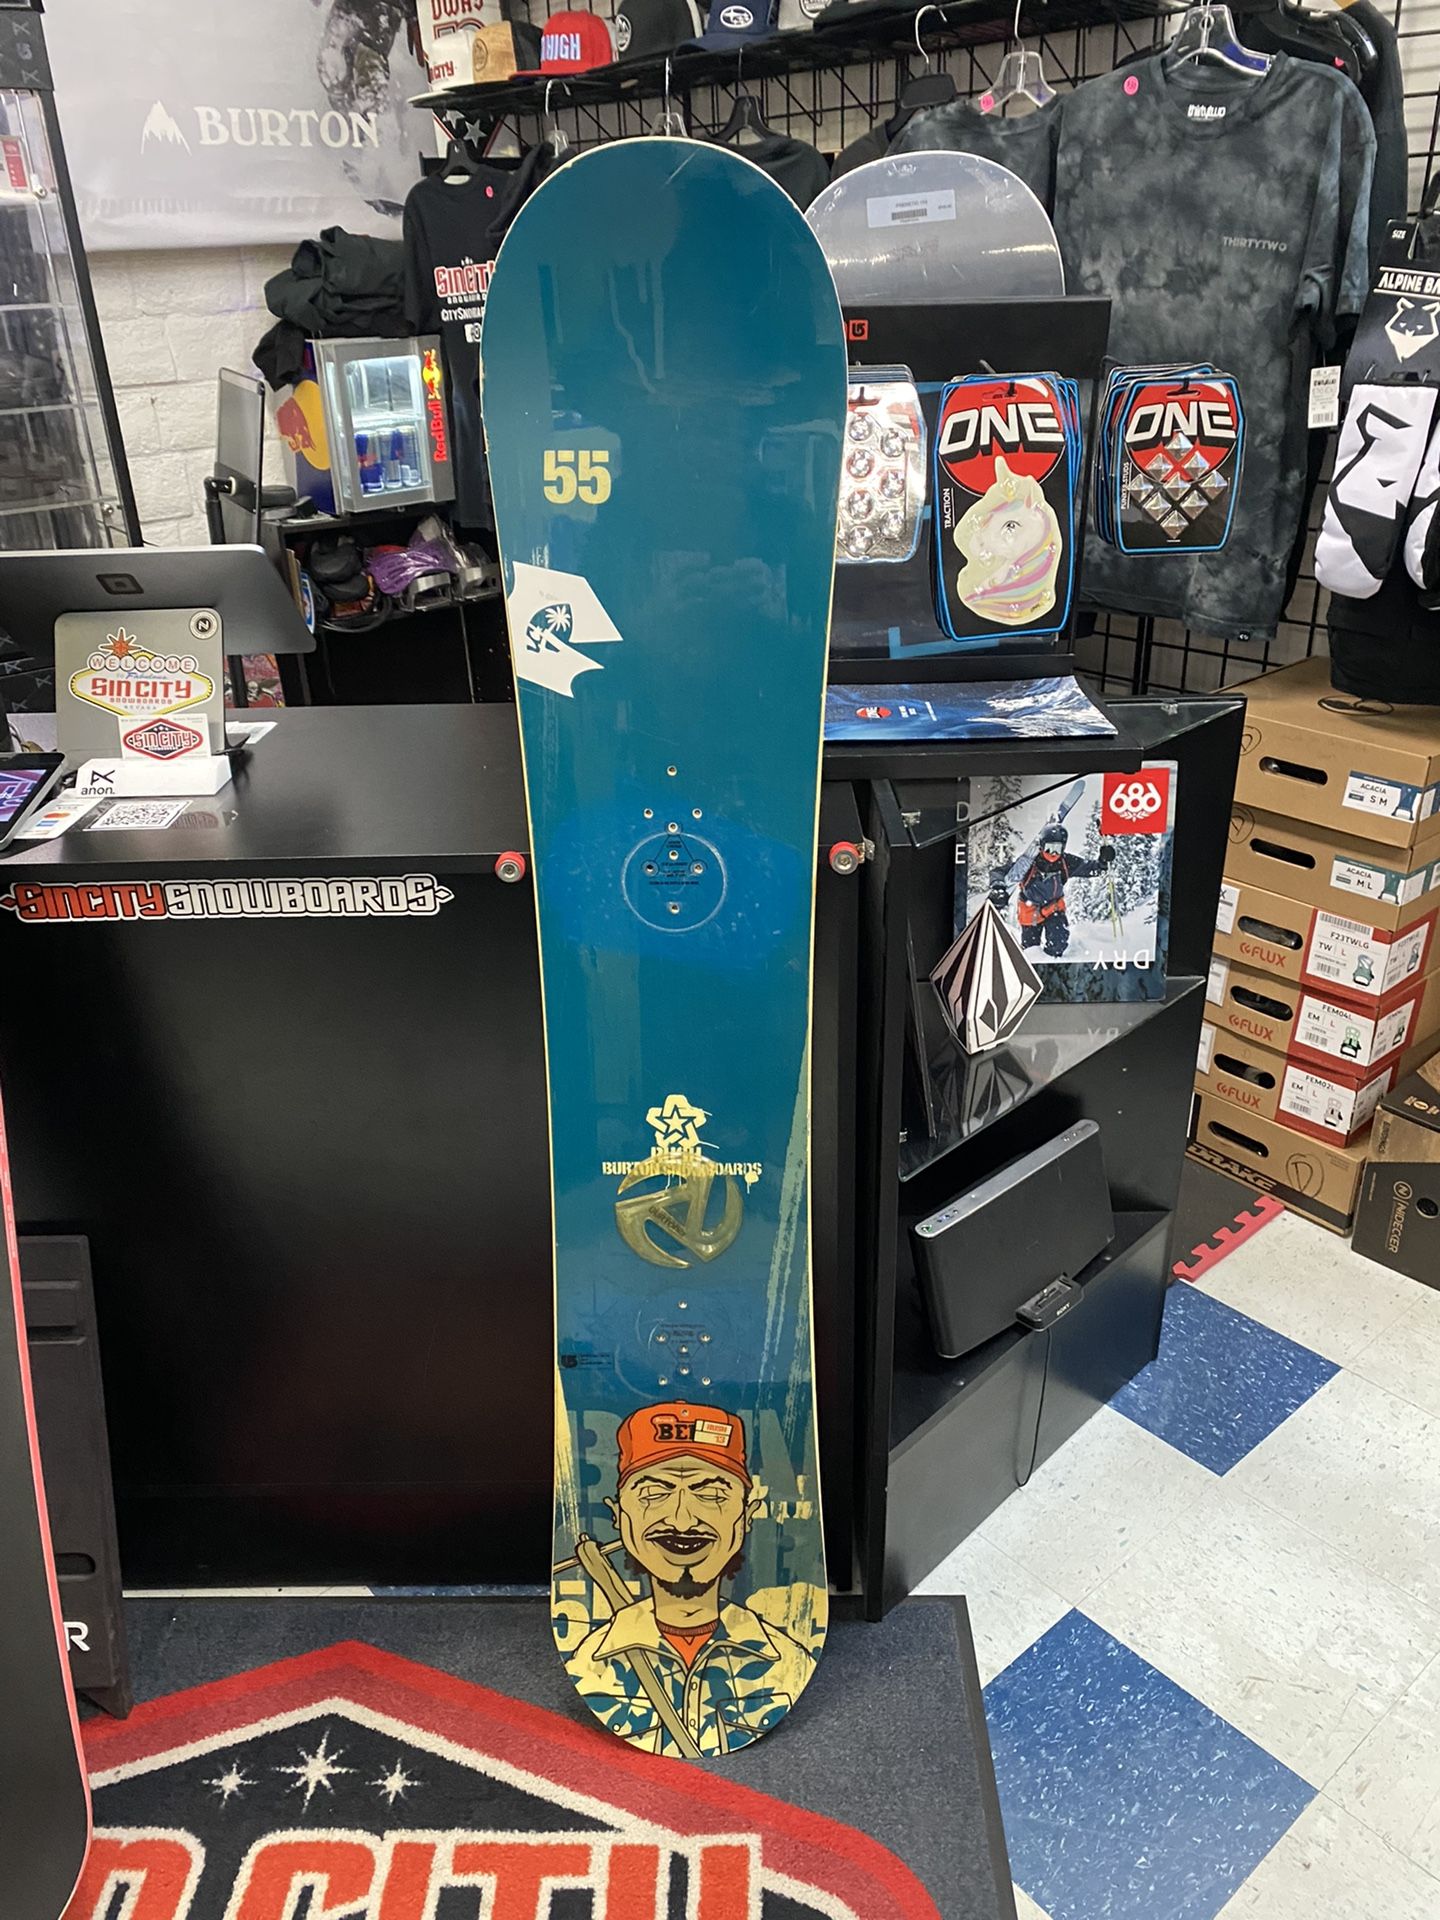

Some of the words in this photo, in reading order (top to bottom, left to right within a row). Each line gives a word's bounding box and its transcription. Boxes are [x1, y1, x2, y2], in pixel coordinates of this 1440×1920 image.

[193, 105, 380, 148] BURTON
[1223, 236, 1288, 252] THIRTYTWO
[1392, 230, 1407, 239] SIZE
[1378, 272, 1422, 293] ALPINE
[939, 402, 1066, 455] ONE
[1125, 401, 1238, 444] ONE
[543, 450, 611, 504] 55
[943, 488, 951, 528] TRACTION
[92, 657, 193, 671] WELCOME
[135, 679, 192, 699] CITY
[80, 786, 116, 796] anon.
[1109, 783, 1162, 814] 686
[1360, 782, 1387, 795] ACACIA
[1346, 867, 1372, 880] ACACIA
[1319, 942, 1333, 952] TW
[1330, 931, 1370, 950] F23TWLG
[1250, 944, 1287, 968] FLUX
[1307, 1012, 1321, 1022] EM
[1321, 1004, 1353, 1021] FEM04L
[1240, 1019, 1274, 1042] FLUX
[1291, 1081, 1304, 1092] EM
[1305, 1075, 1336, 1092] FEM02L
[1228, 1086, 1262, 1109] FLUX
[1187, 1147, 1278, 1191] DRAKE
[1388, 1202, 1408, 1254] NIDECKER
